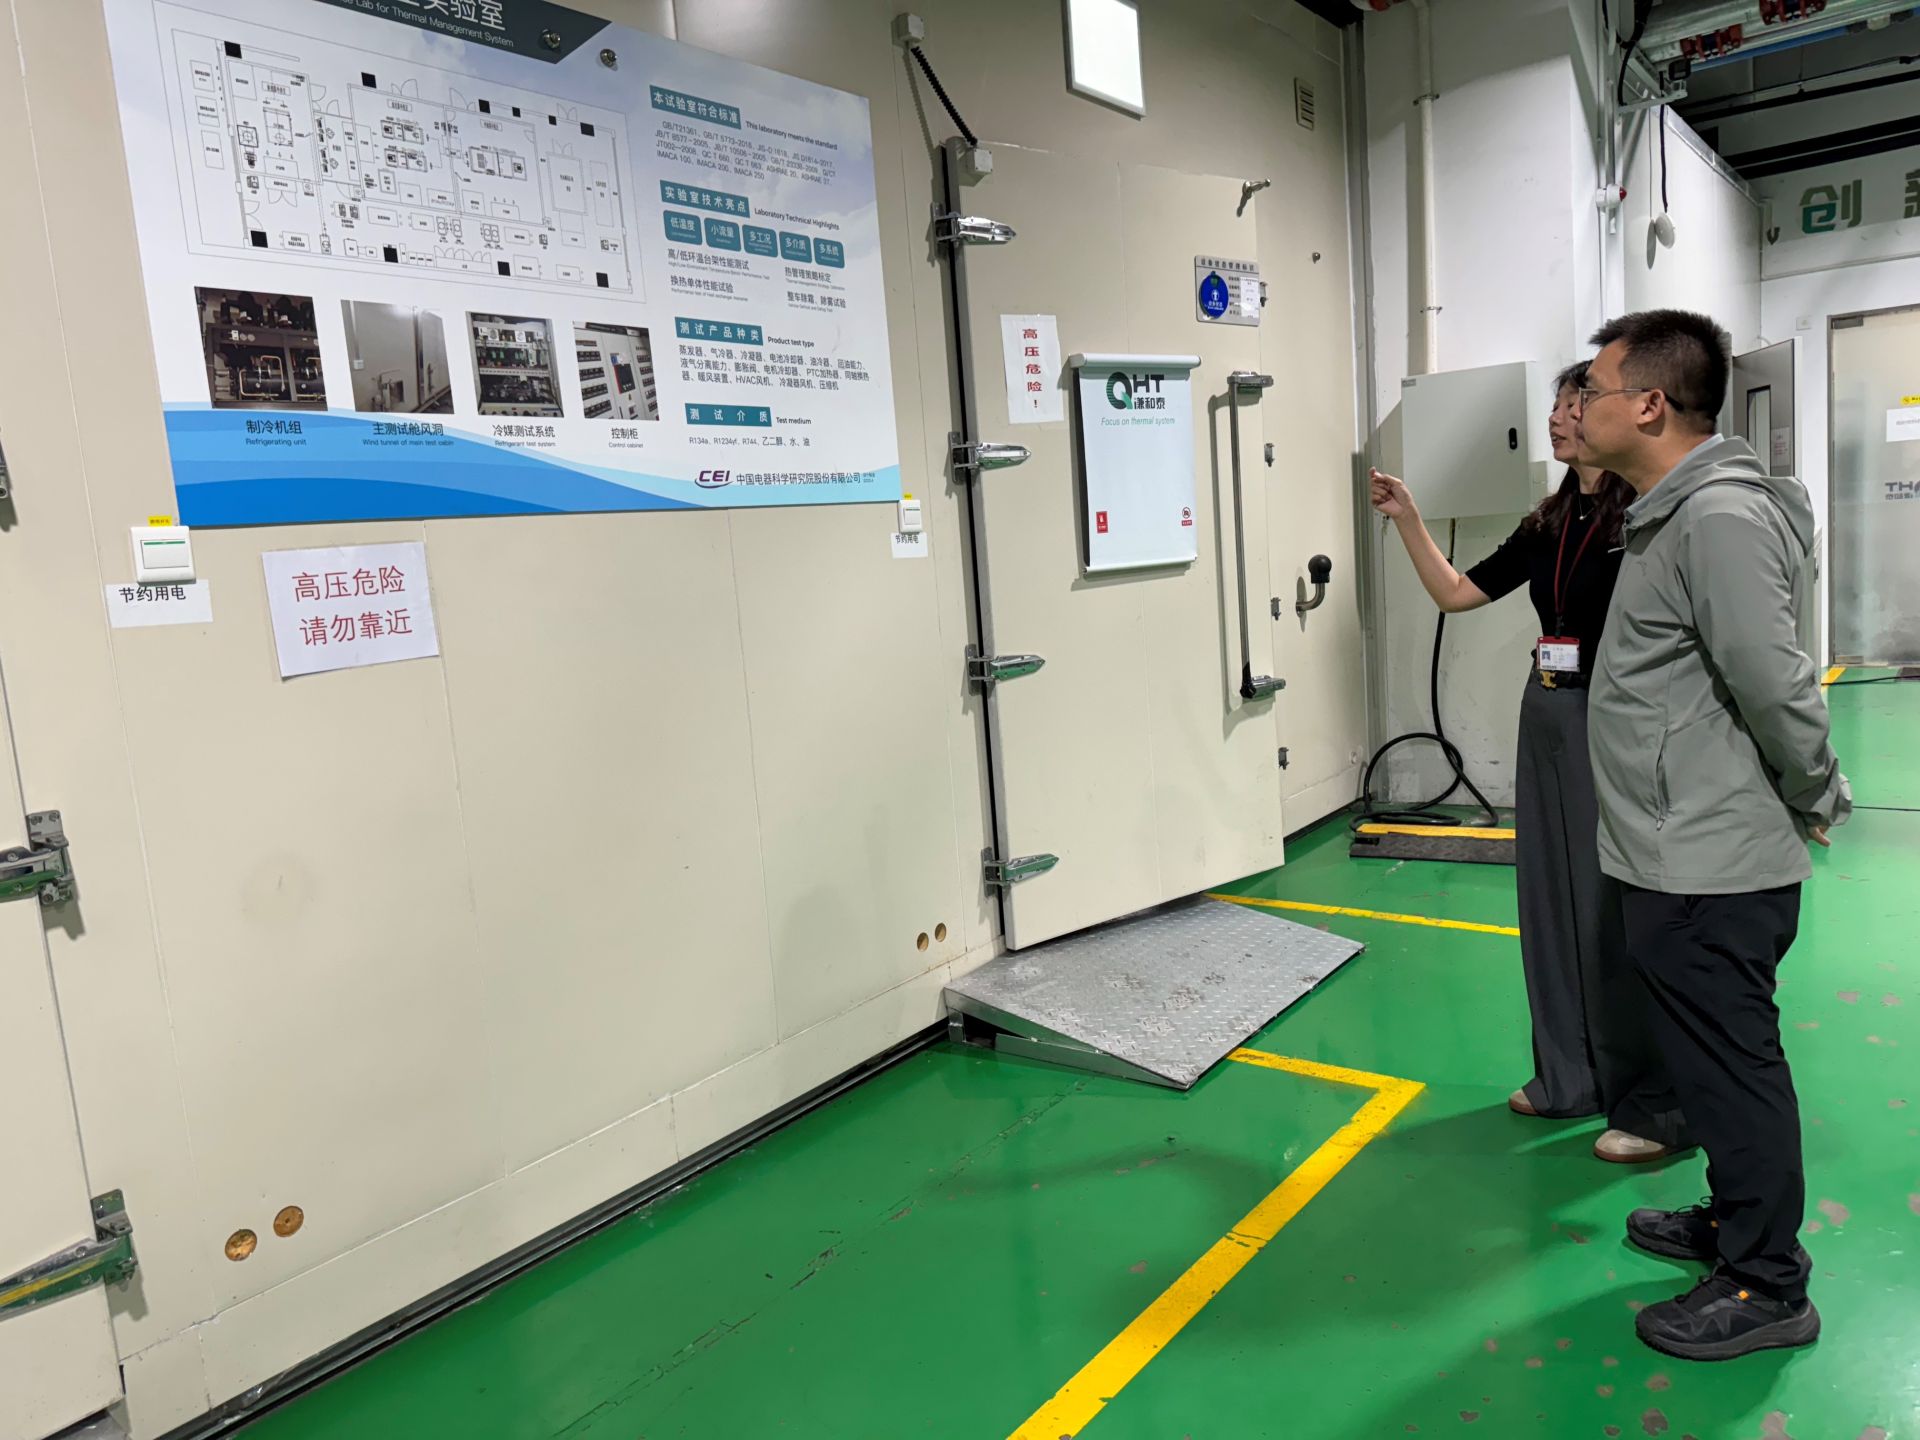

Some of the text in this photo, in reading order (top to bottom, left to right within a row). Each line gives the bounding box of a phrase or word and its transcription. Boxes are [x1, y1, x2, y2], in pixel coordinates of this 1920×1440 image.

[376, 2, 390, 13] for
[392, 6, 427, 24] Thermal
[429, 16, 483, 39] Management
[484, 32, 514, 47] System
[654, 92, 739, 124] 本试验室符合标准
[745, 120, 758, 131] This
[758, 124, 787, 139] laboratory
[804, 136, 814, 144] the
[814, 140, 838, 151] standard
[665, 186, 746, 213] 实验室技术亮点
[754, 208, 840, 231] Laboratory Technical Highlights
[711, 224, 734, 238] 小流量
[680, 321, 760, 342] 测试产品种类
[767, 336, 790, 345] Product
[802, 340, 815, 348] type
[1106, 371, 1165, 410] QHT
[1134, 397, 1166, 410] 谦和泰
[690, 408, 768, 423] 测试介质
[776, 416, 812, 425] Test medium
[1100, 416, 1176, 427] Focus on thermal system
[246, 419, 303, 435] 制冷机组
[373, 422, 444, 436] 主测试舱风洞
[492, 424, 556, 438] 冷媒测试系统
[611, 427, 639, 440] 控制柜
[246, 438, 307, 447] Refrigerating unit
[698, 470, 731, 482] CEI
[736, 472, 861, 486] 中国电器科学研究院股份有限公司
[291, 565, 406, 603] 高压危险
[118, 584, 187, 603] 节约用电
[299, 607, 413, 647] 请勿靠近
